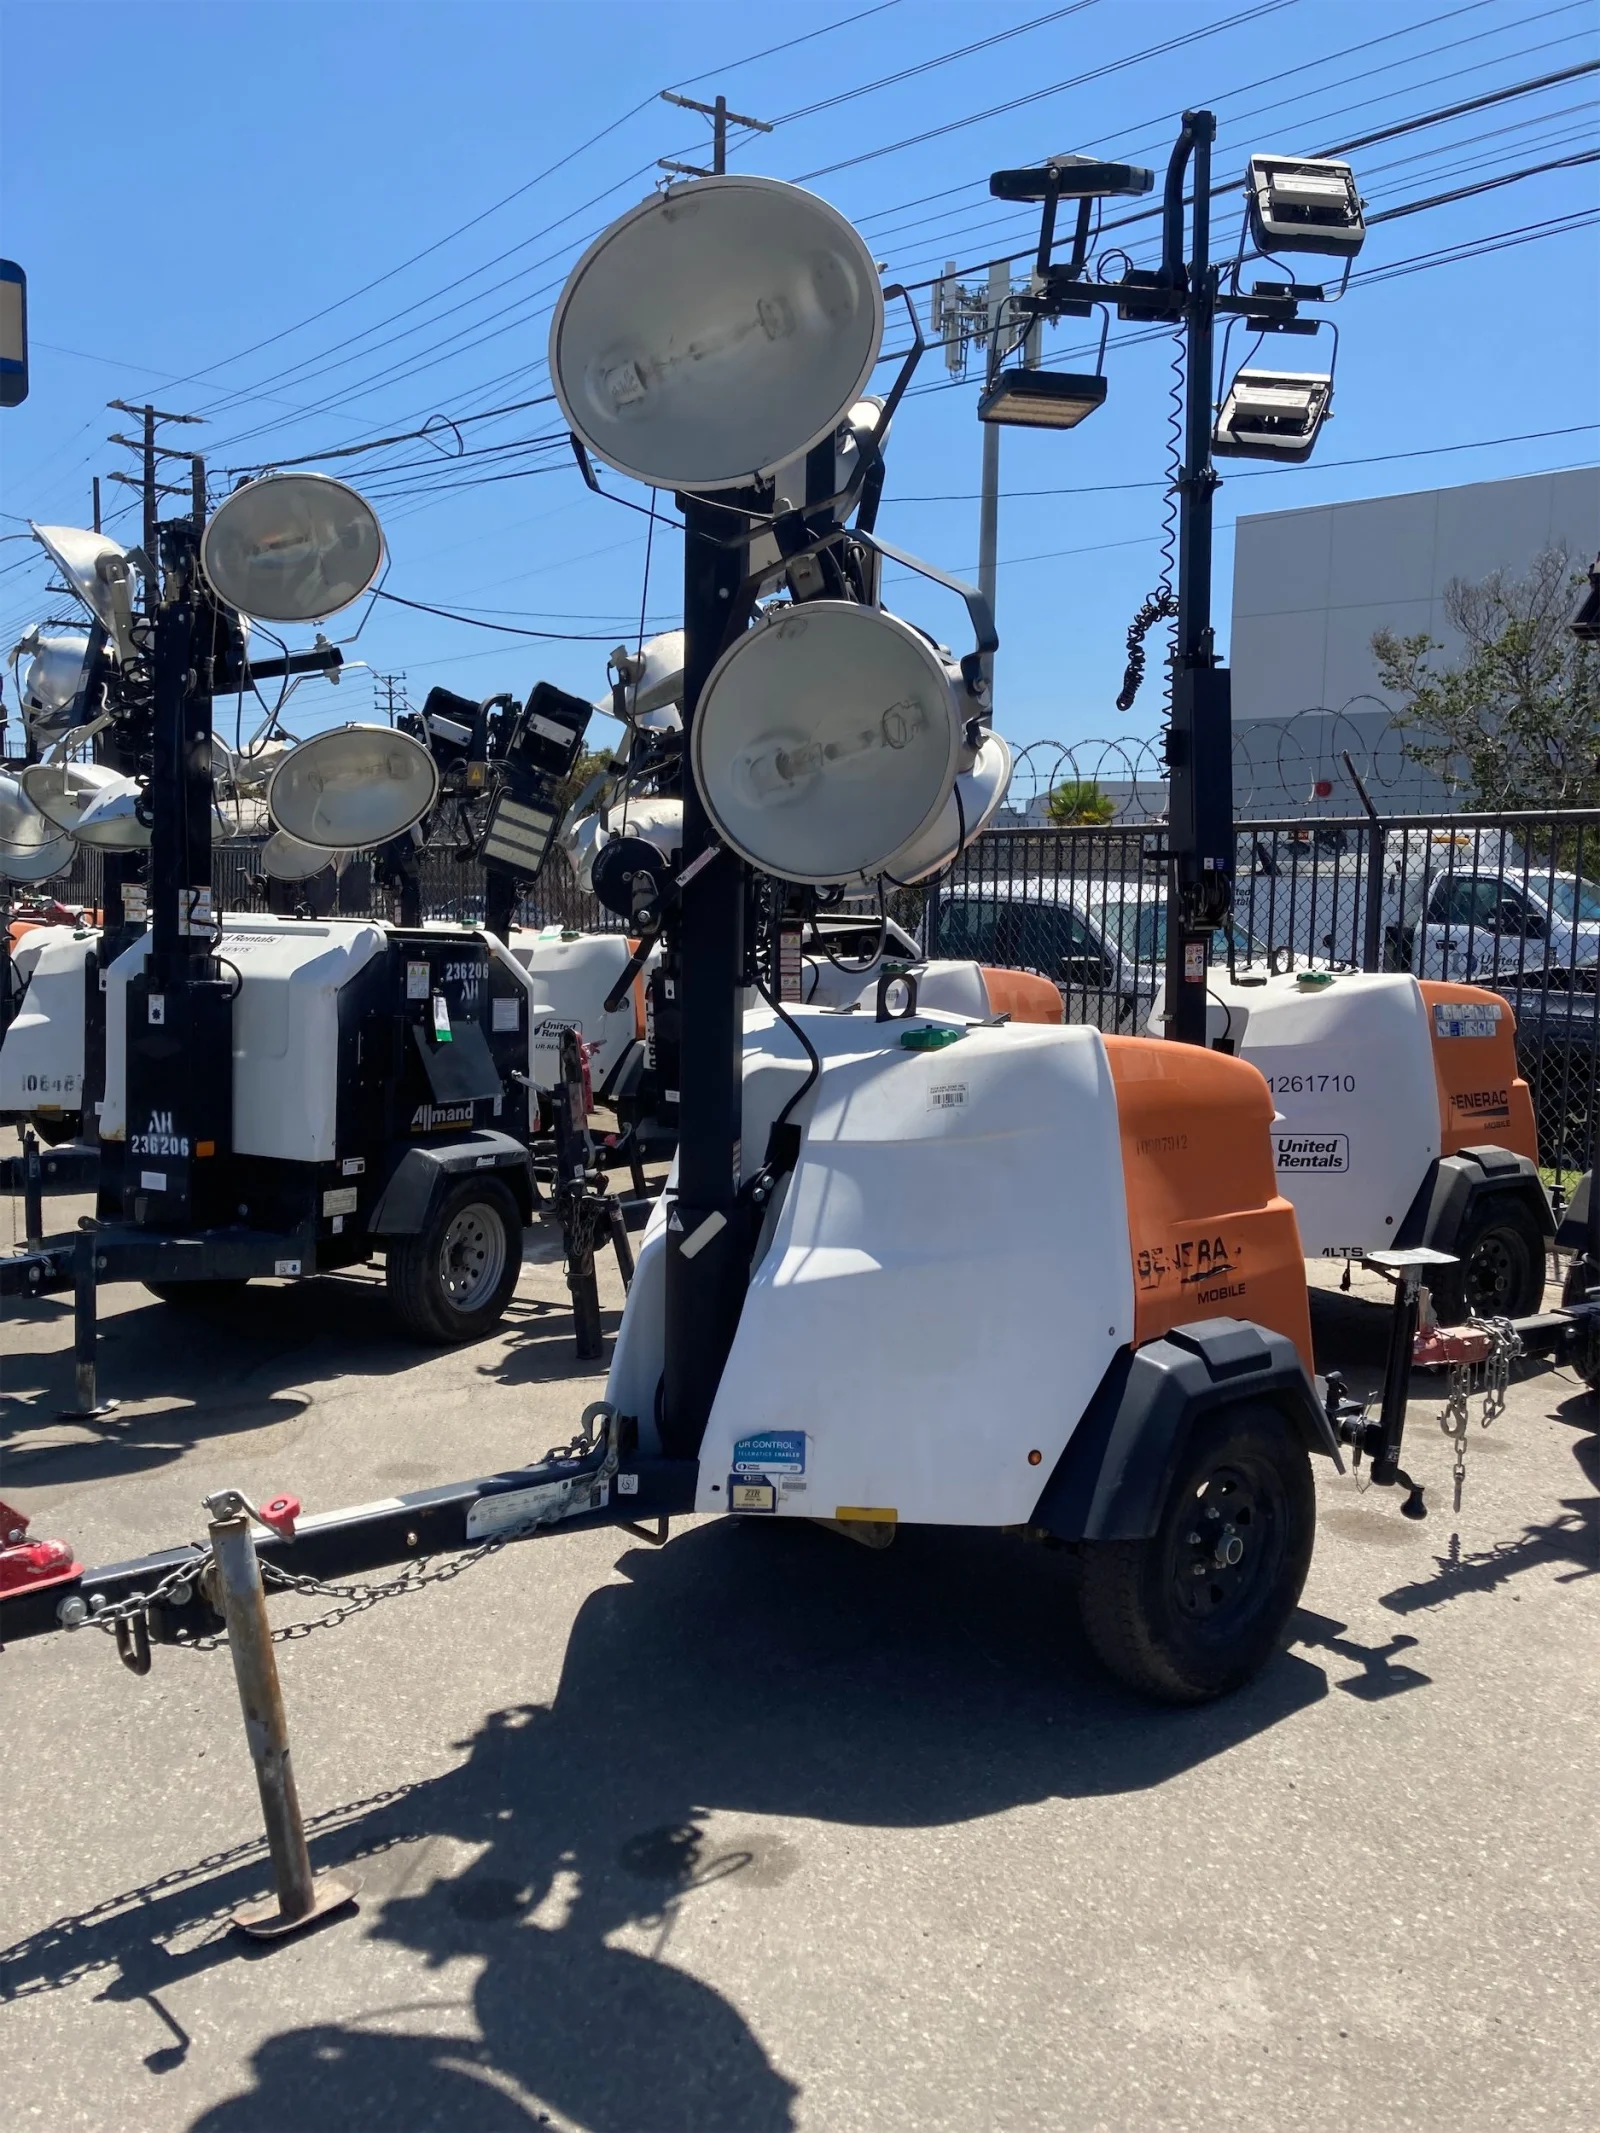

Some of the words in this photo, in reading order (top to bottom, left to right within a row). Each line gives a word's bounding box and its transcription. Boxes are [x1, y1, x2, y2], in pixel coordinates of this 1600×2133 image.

[232, 934, 277, 944] Rentals
[446, 962, 489, 980] 236206
[542, 1021, 577, 1031] United
[1267, 1075, 1356, 1093] 1261710
[411, 1101, 474, 1131] Allmand
[131, 1135, 189, 1157] 236206
[1278, 1140, 1338, 1153] United
[1277, 1154, 1343, 1167] Rentals
[1197, 1283, 1247, 1305] MOBILE
[752, 1441, 795, 1449] CONTROL
